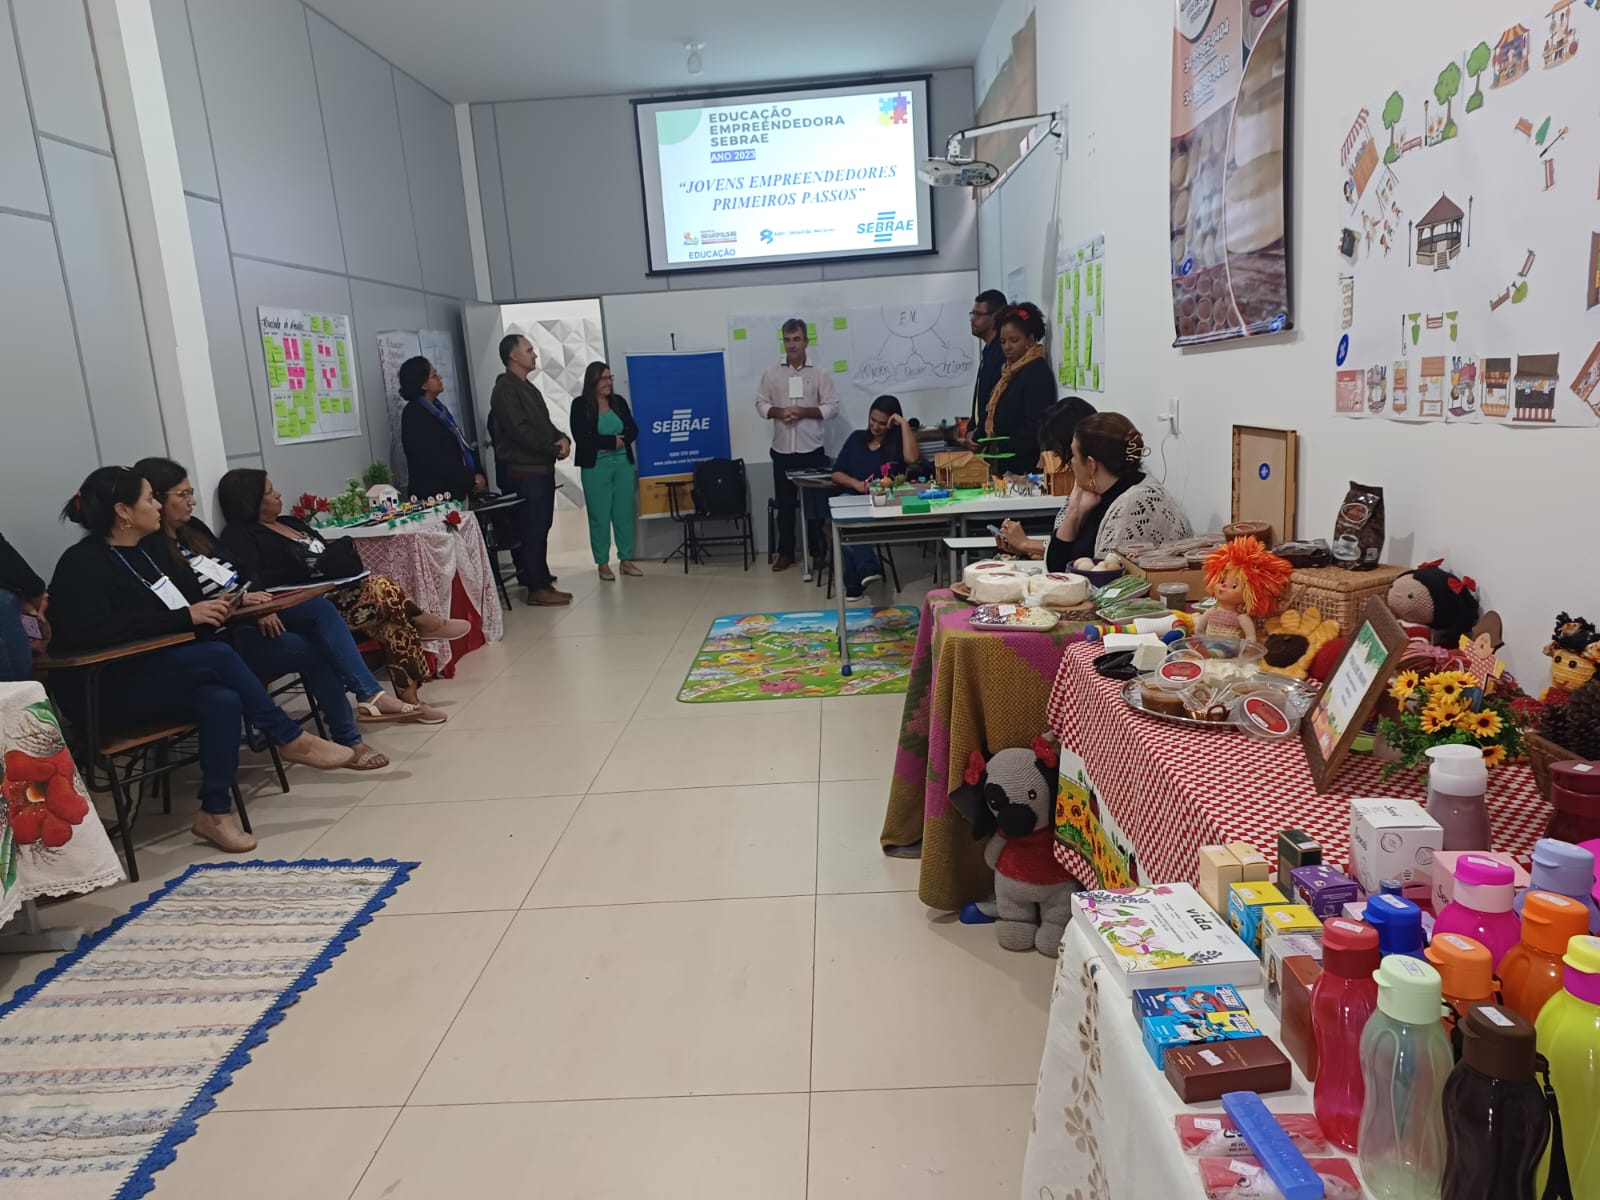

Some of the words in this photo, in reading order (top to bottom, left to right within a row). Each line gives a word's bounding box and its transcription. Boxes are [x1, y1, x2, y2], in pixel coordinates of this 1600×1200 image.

[709, 105, 792, 124] EDUCAÇÃO
[709, 114, 845, 136] EMPREENDEDORA
[710, 133, 769, 147] SEBRAE
[711, 151, 732, 163] ANO
[734, 149, 756, 161] 2023
[749, 165, 897, 189] EMPREENDEDORES
[712, 192, 797, 211] PRIMEIROS
[857, 218, 914, 235] SEBRAE
[688, 248, 736, 260] EDUCAÇÃO
[652, 417, 711, 434] SEBRAE
[1185, 908, 1213, 932] vida
